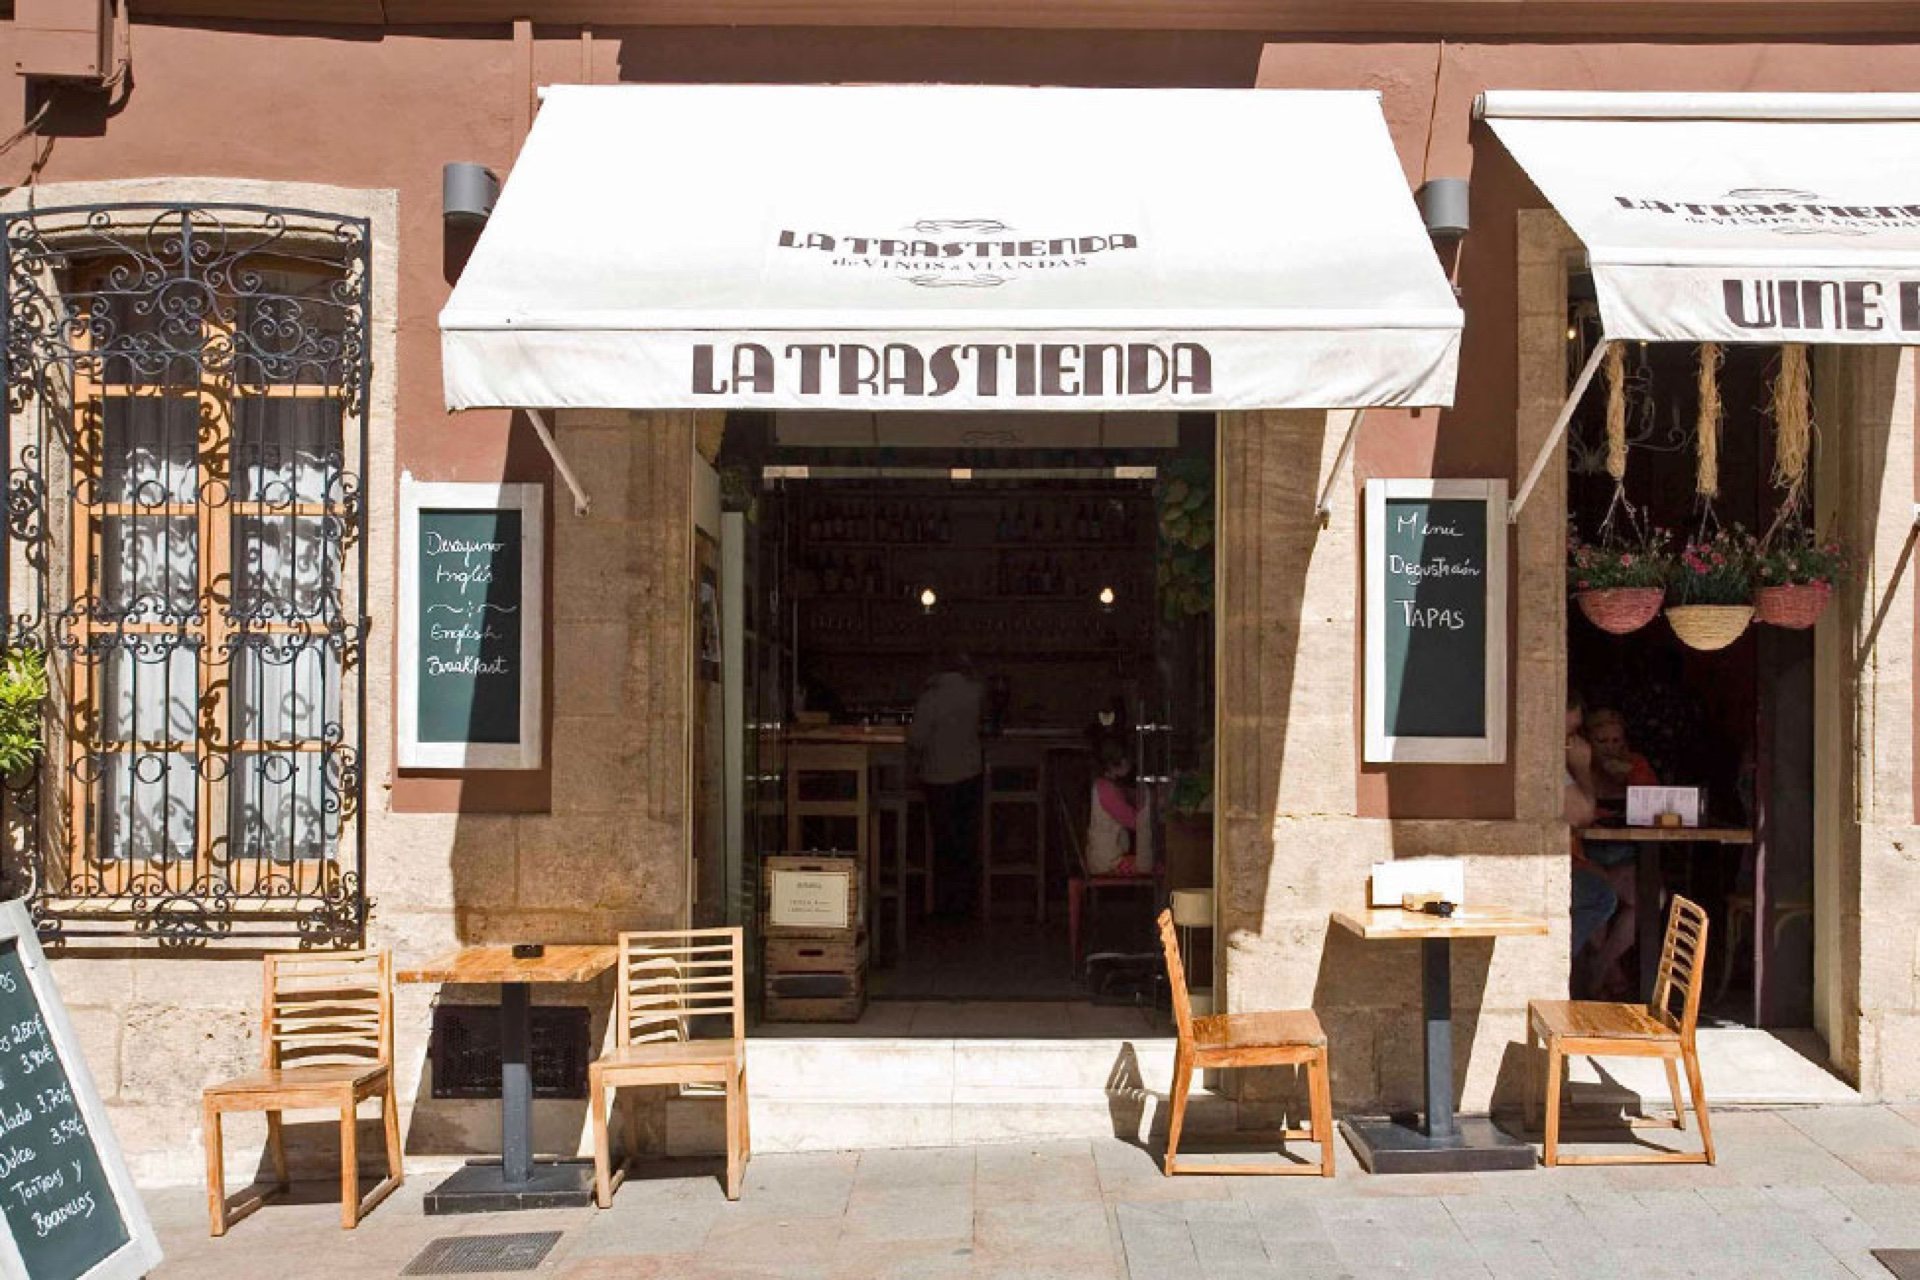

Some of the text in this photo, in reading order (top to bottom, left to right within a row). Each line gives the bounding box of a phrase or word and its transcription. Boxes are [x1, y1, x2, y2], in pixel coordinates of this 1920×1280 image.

[778, 230, 1138, 258] LA TRASTIENDA
[863, 258, 946, 270] VINOS
[966, 258, 1087, 270] VIANDAS
[1722, 279, 1884, 331] WINE
[692, 342, 1212, 396] LA TRASTIENDA
[1394, 599, 1464, 629] TAPAS
[431, 622, 503, 654] English
[427, 655, 510, 676] Breakfast
